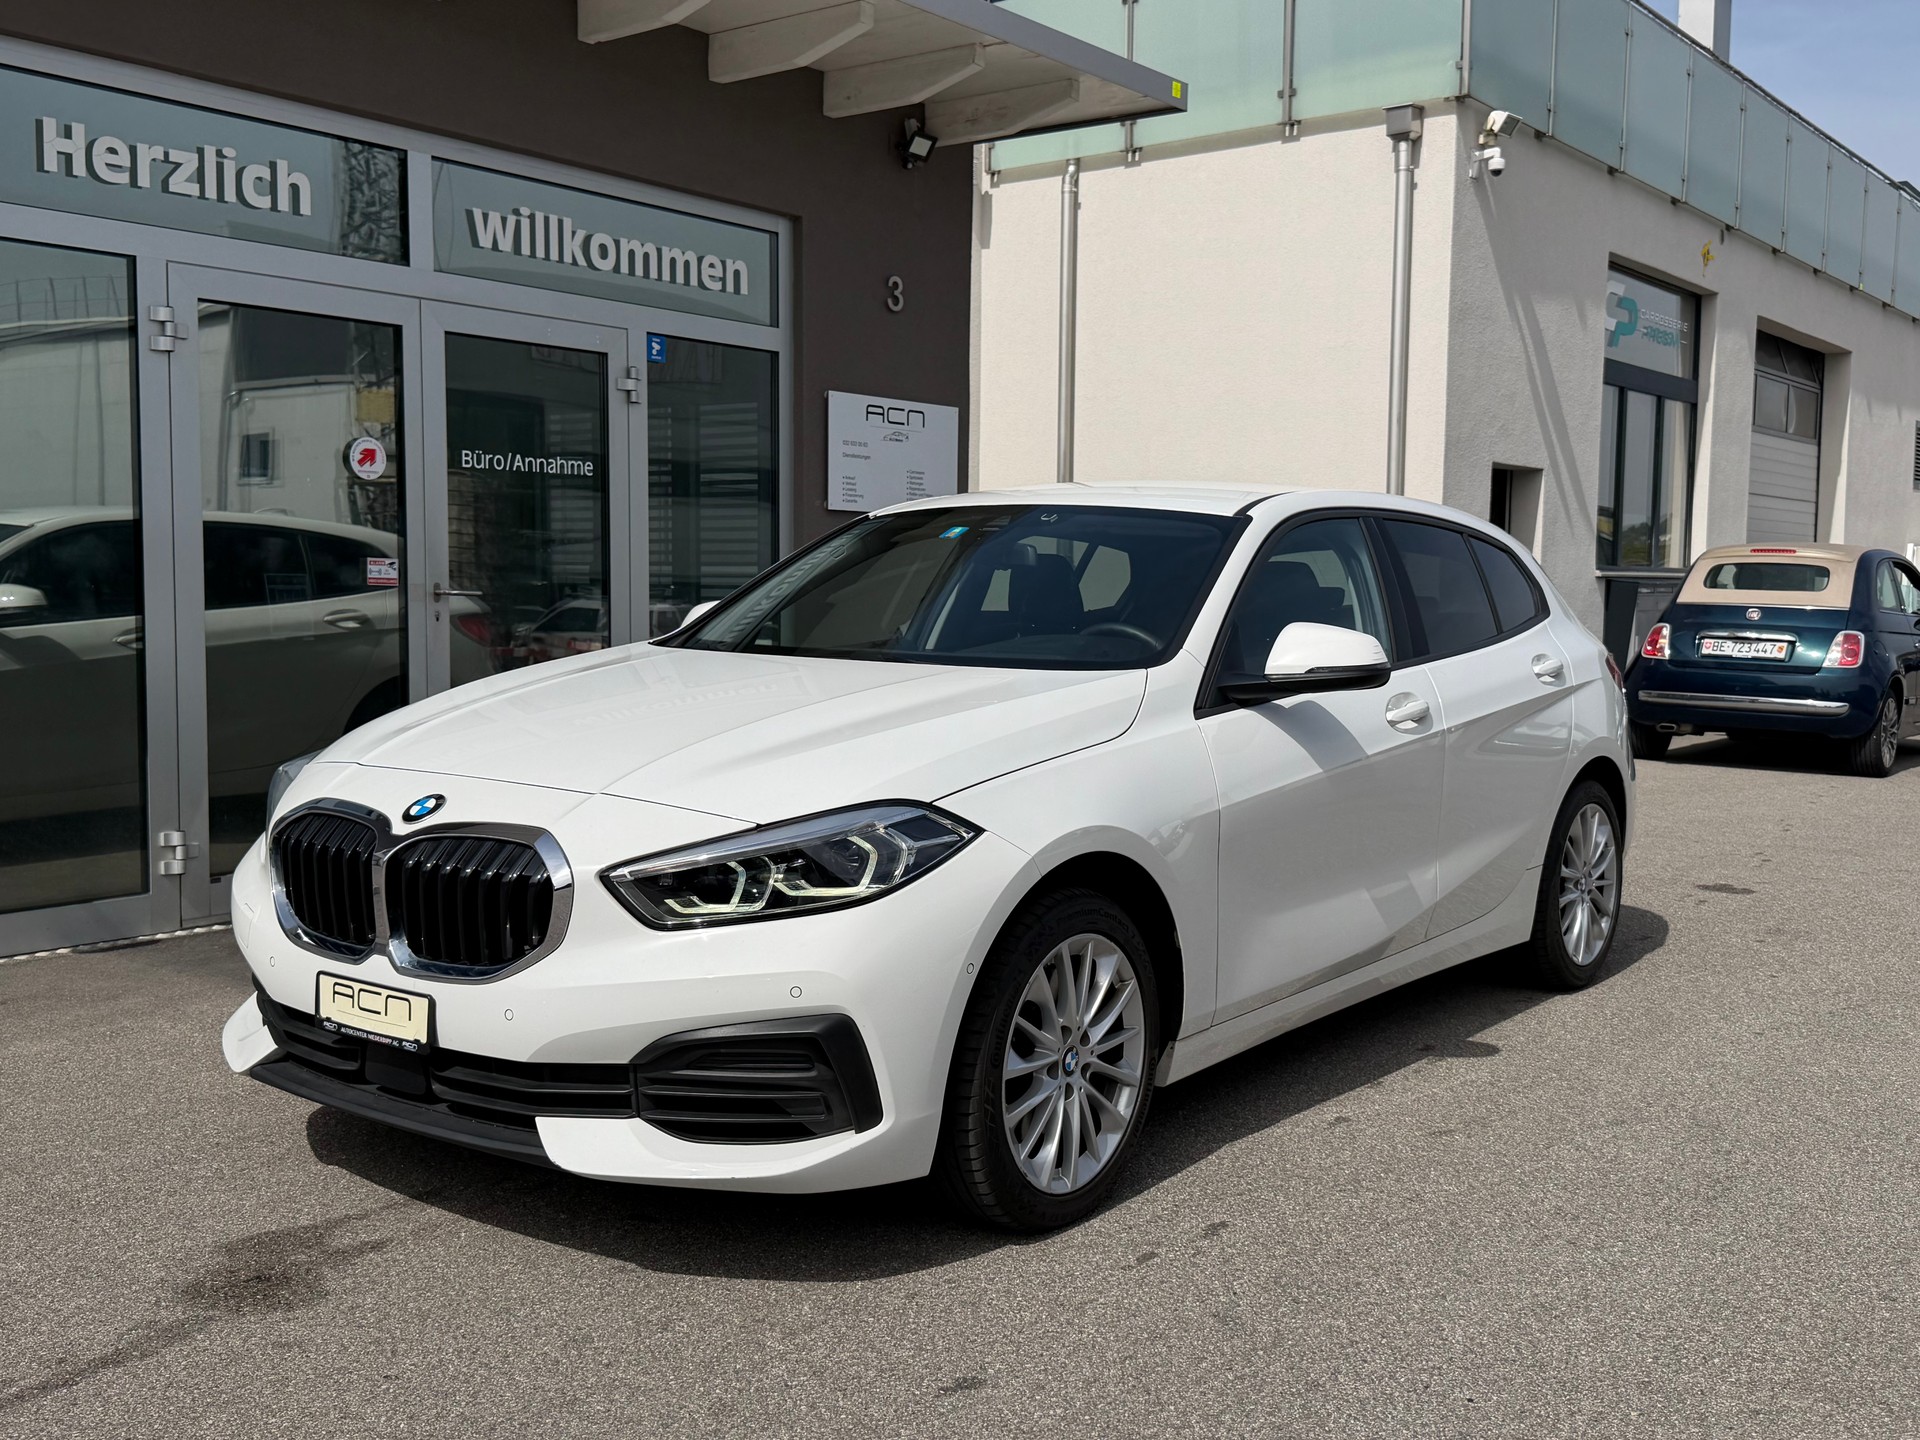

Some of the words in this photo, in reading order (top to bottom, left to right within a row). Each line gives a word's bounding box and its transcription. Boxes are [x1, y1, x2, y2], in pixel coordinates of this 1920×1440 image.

[38, 116, 312, 216] Herzlich
[468, 206, 749, 295] willkommen
[887, 275, 904, 312] 3
[865, 404, 925, 428] ACN
[461, 450, 594, 477] Büro/Annahme
[332, 981, 412, 1021] ACN
